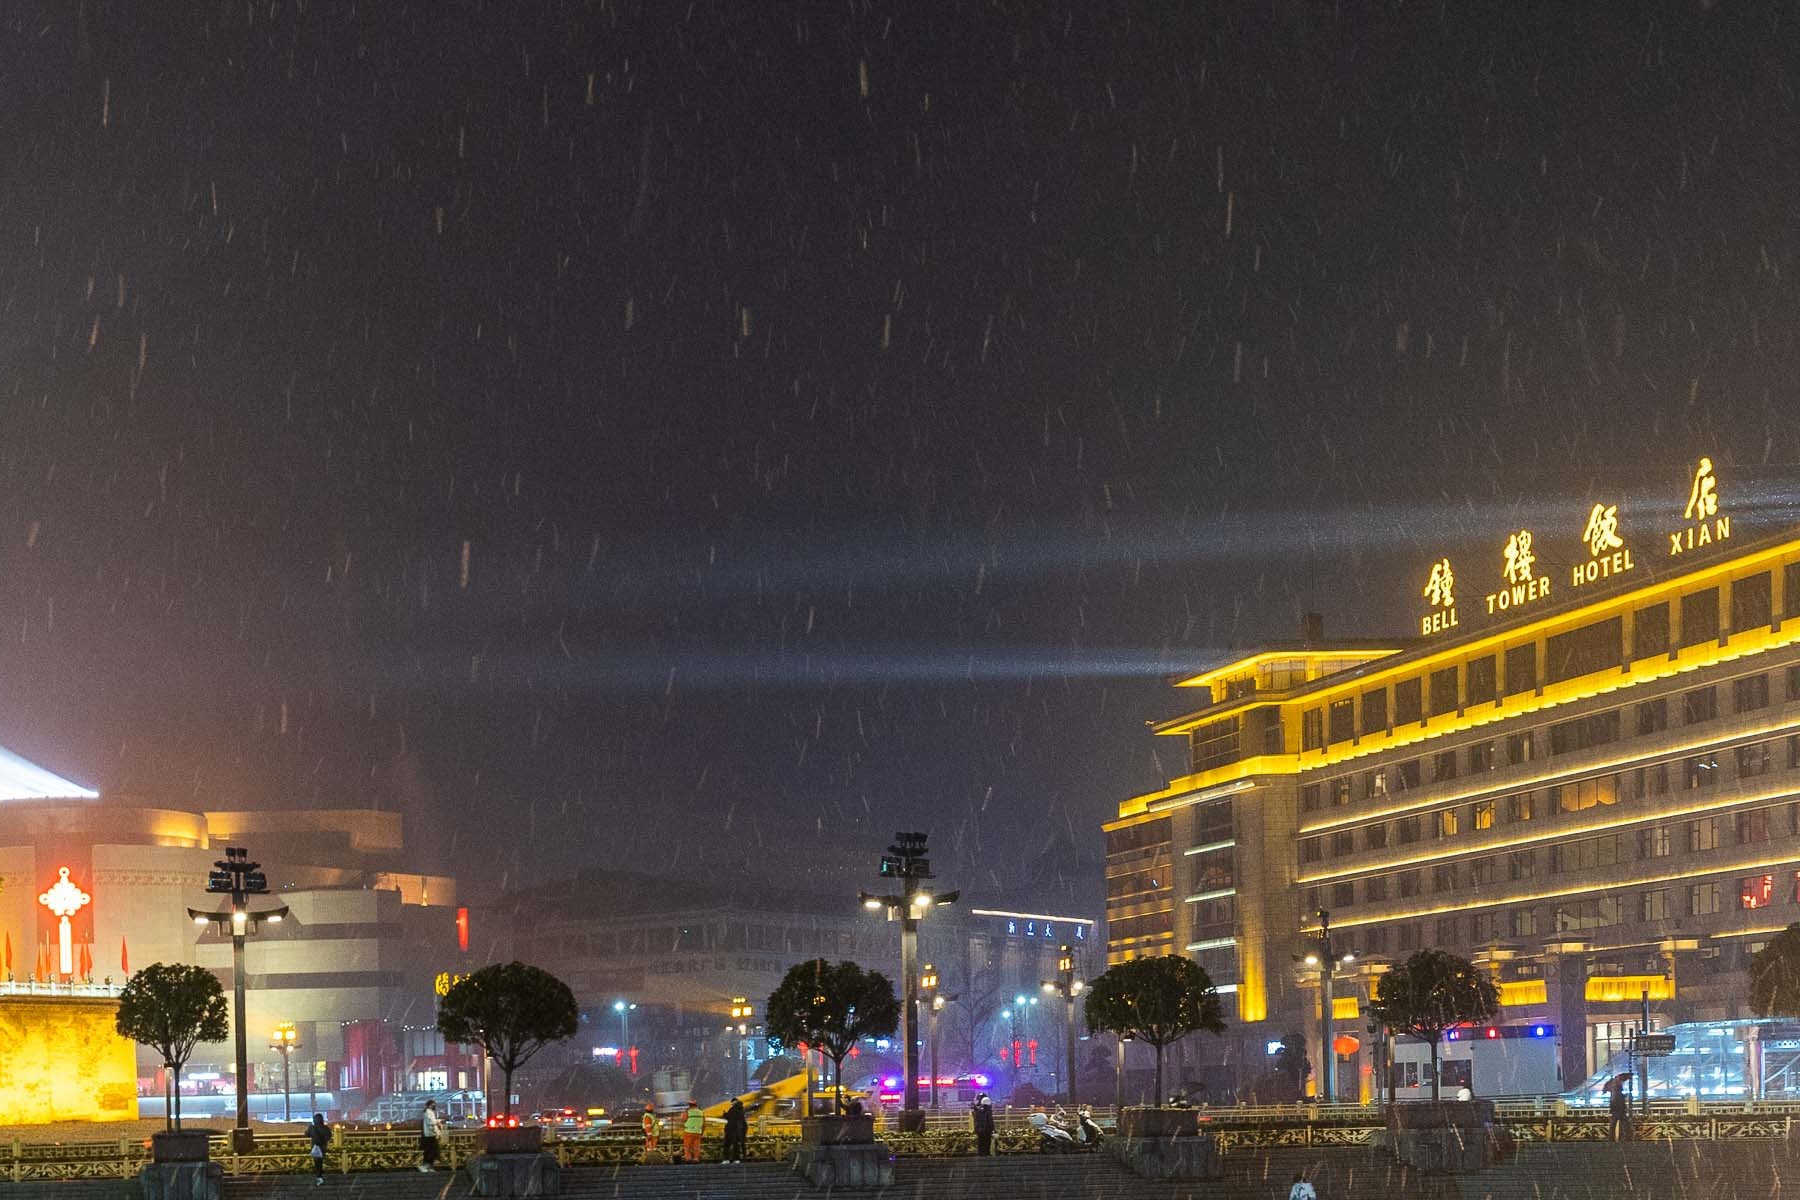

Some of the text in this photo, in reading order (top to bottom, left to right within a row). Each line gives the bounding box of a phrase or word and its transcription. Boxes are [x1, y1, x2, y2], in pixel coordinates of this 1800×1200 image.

[1422, 516, 1731, 636] BELL TOWER HOTEL XIAN
